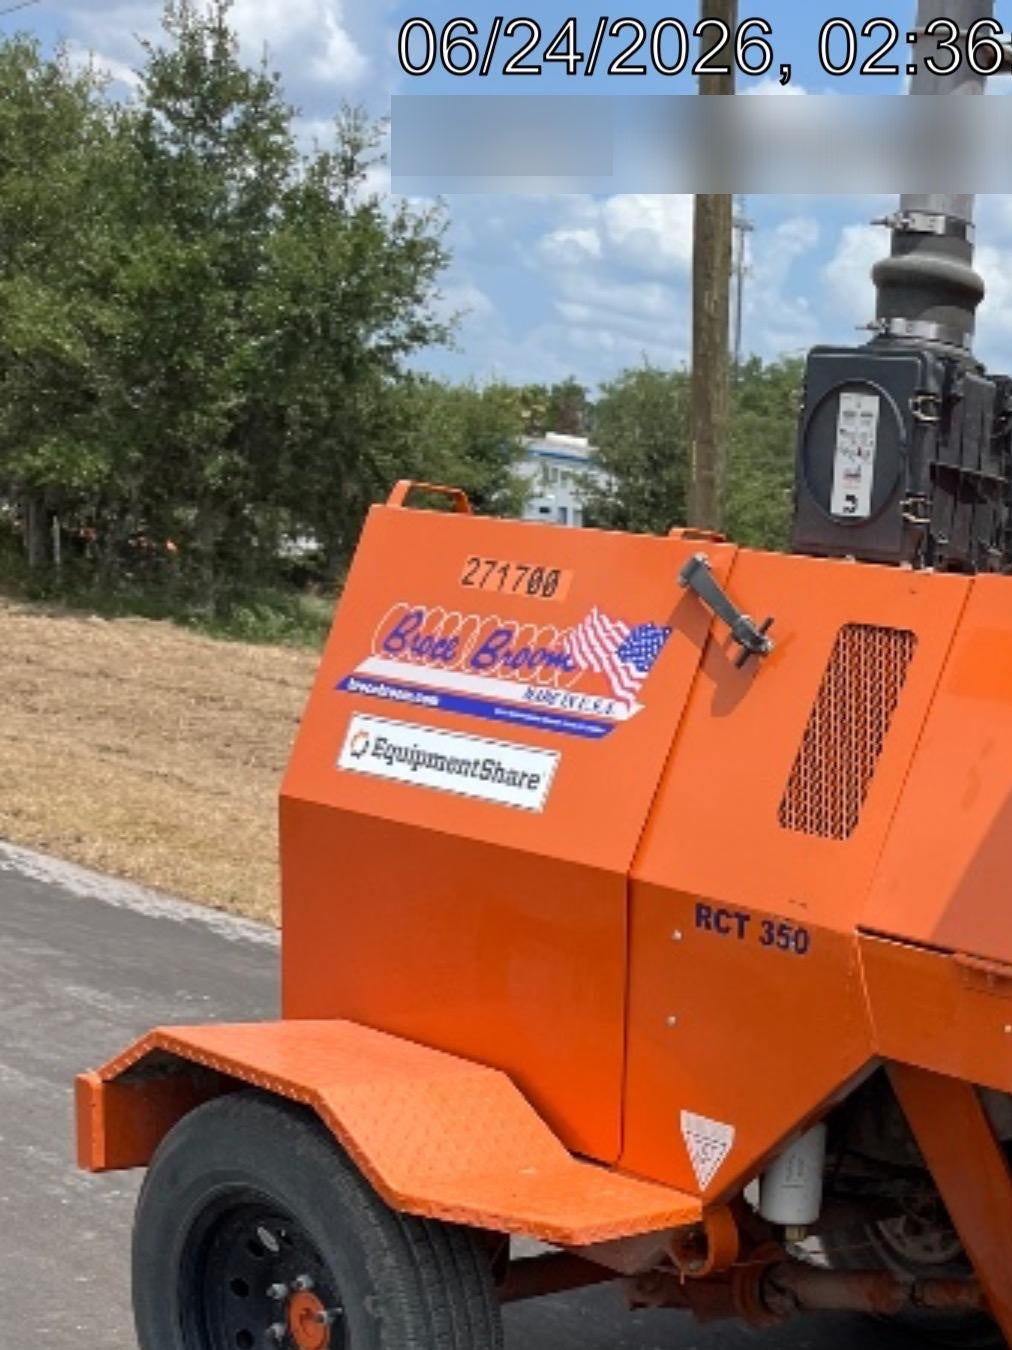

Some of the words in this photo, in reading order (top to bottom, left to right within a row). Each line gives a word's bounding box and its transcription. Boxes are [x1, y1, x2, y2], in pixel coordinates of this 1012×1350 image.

[383, 609, 459, 662] Broce
[470, 628, 577, 672] Broom
[371, 737, 541, 790] EquipmentShare
[695, 902, 751, 940] RCT
[759, 919, 810, 955] 350
